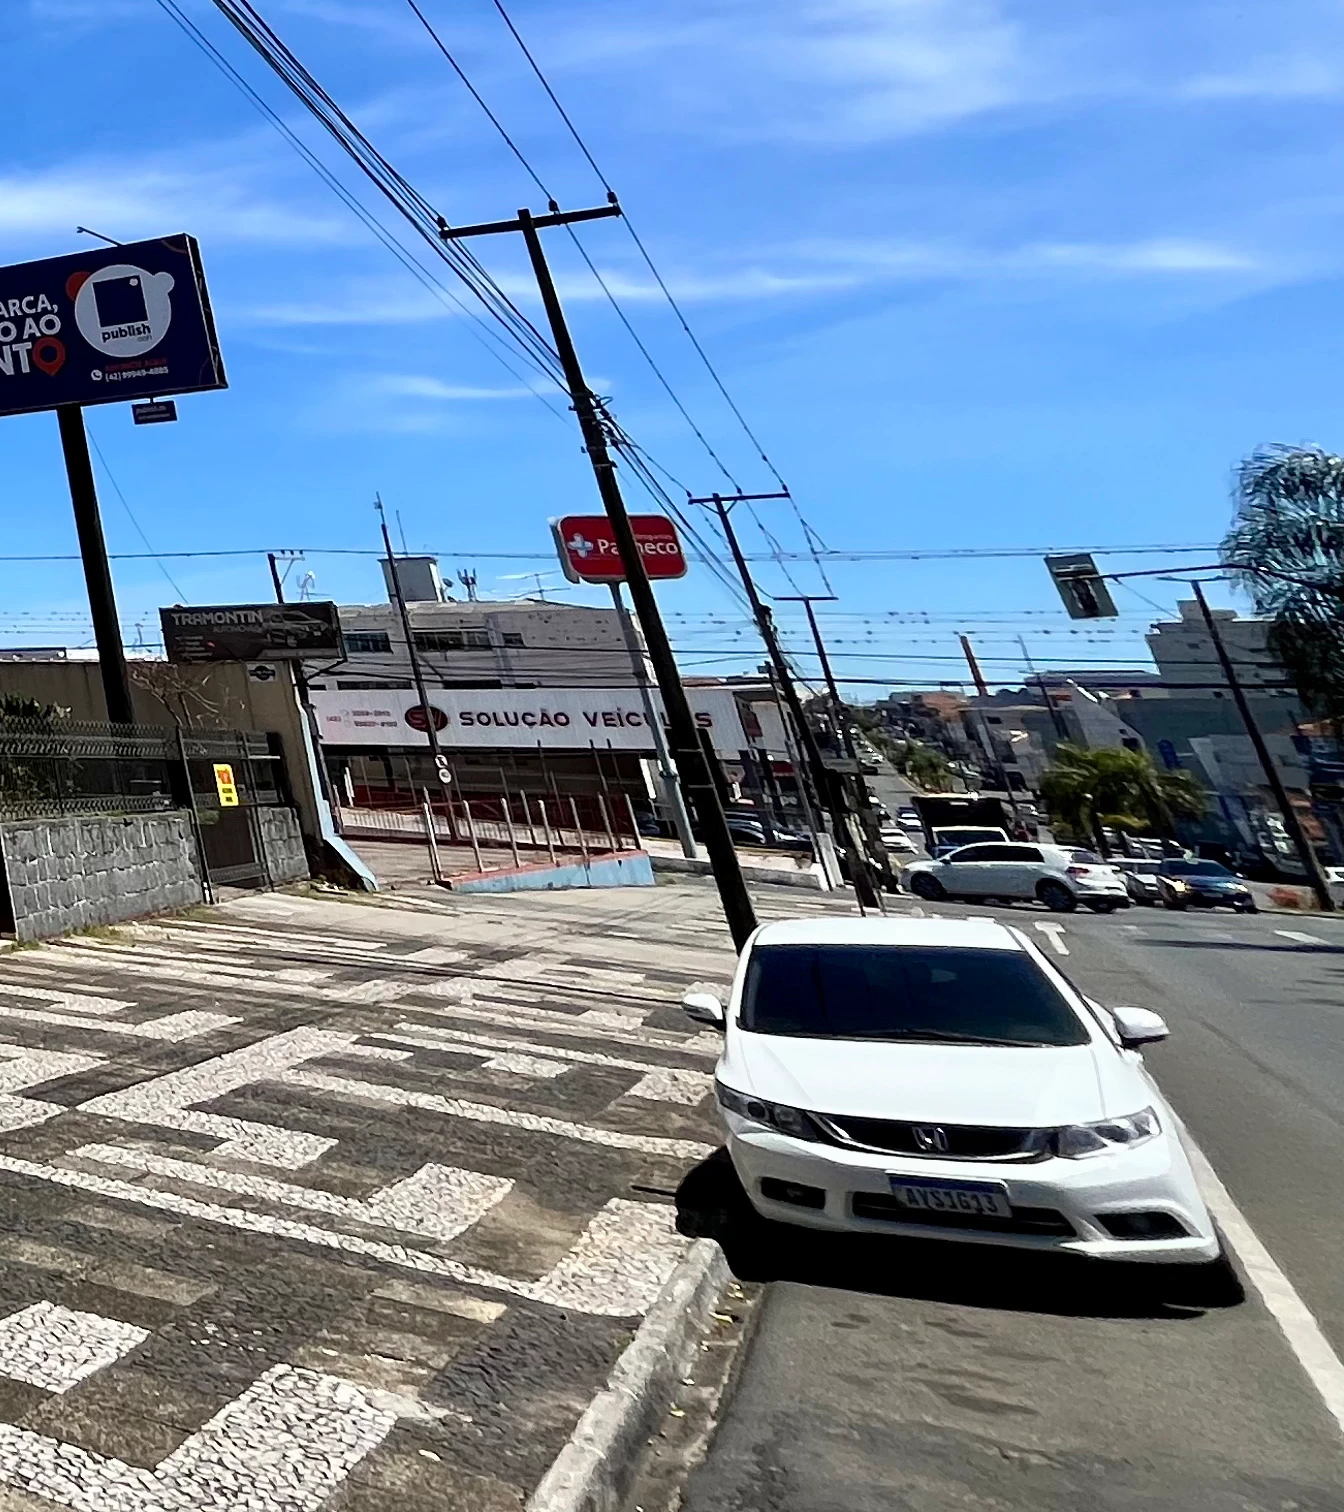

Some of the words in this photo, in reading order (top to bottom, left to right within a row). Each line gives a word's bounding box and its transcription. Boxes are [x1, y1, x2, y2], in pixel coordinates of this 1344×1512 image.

[23, 313, 62, 339] AO
[101, 323, 151, 343] publish
[597, 538, 679, 555] Paeco
[171, 609, 263, 626] TRAMONTIN
[459, 708, 570, 729] SOLUÇÃO
[583, 707, 713, 728] VEÍCLS
